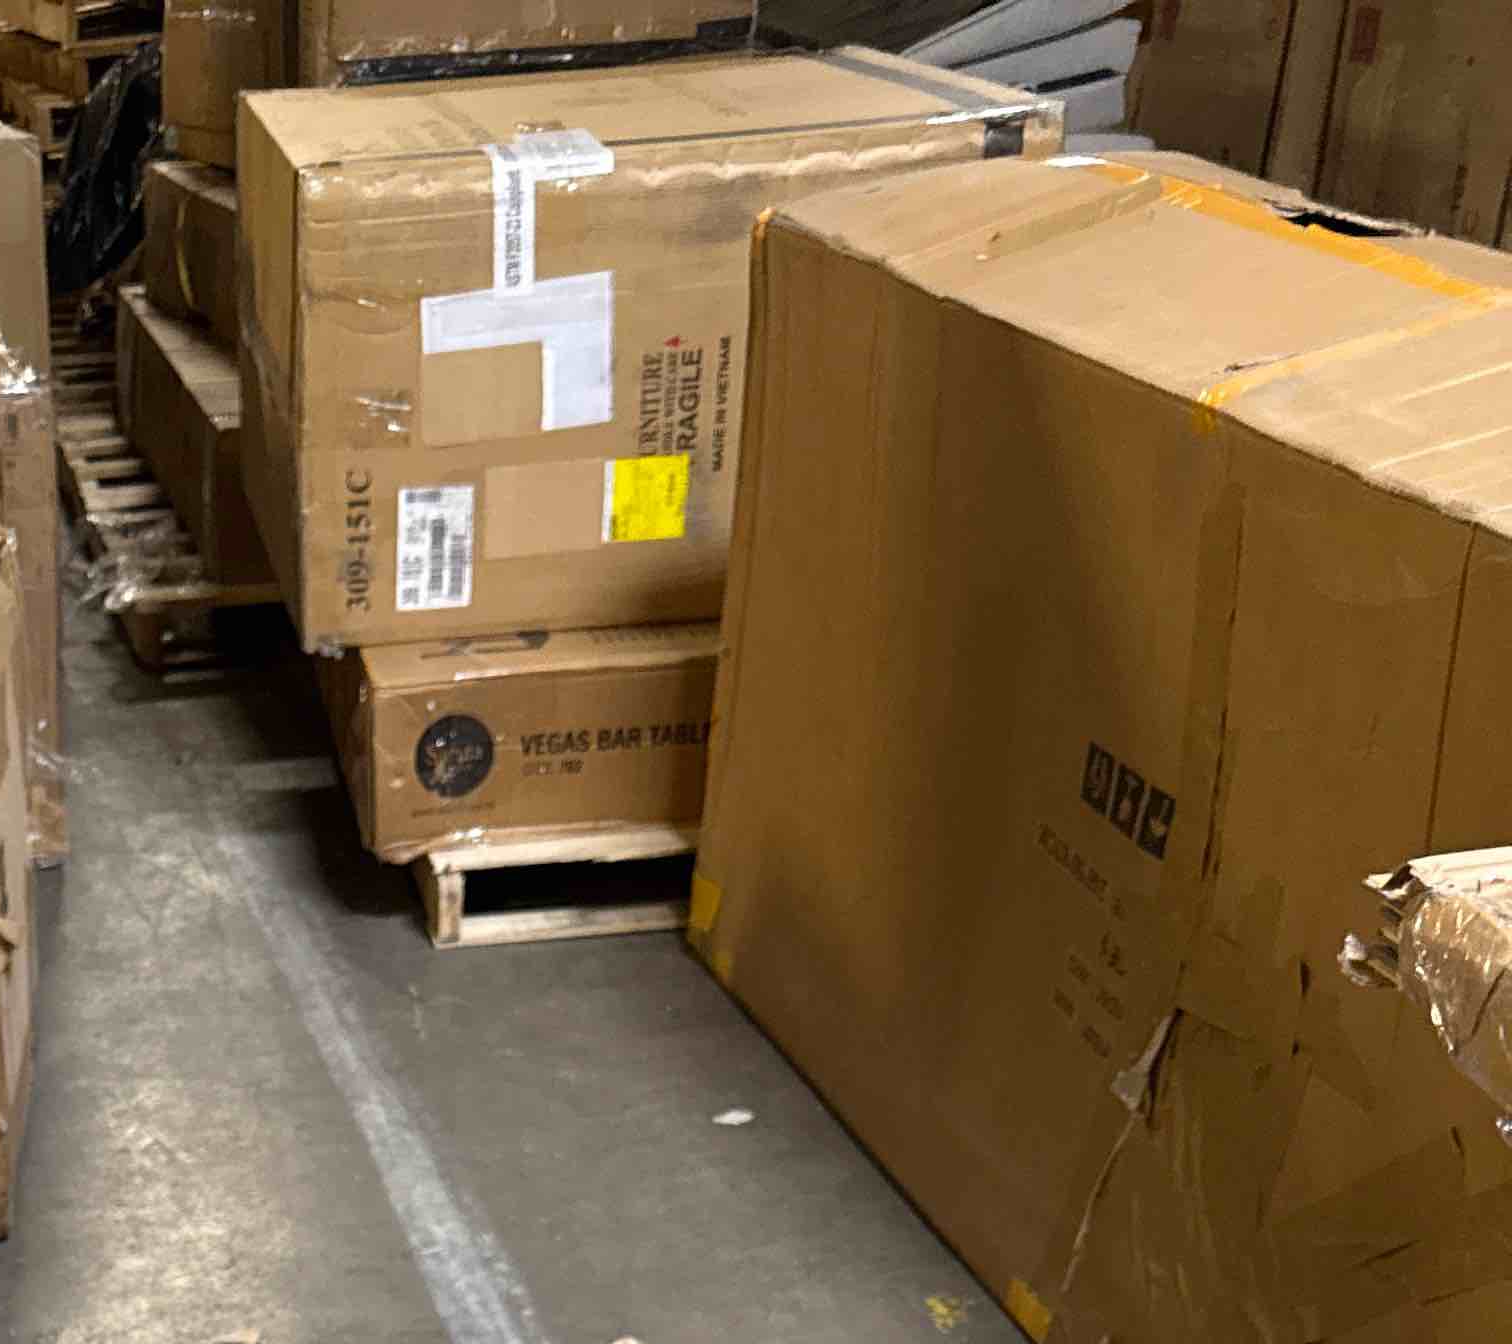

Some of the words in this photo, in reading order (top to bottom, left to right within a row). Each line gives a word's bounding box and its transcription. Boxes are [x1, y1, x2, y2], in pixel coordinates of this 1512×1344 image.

[639, 352, 663, 457] URNITURE
[676, 347, 703, 451] RAGILE
[716, 336, 732, 406] VIETNAM
[345, 469, 373, 611] 309-151C
[520, 729, 589, 755] VEGAS
[596, 725, 641, 751] BAR
